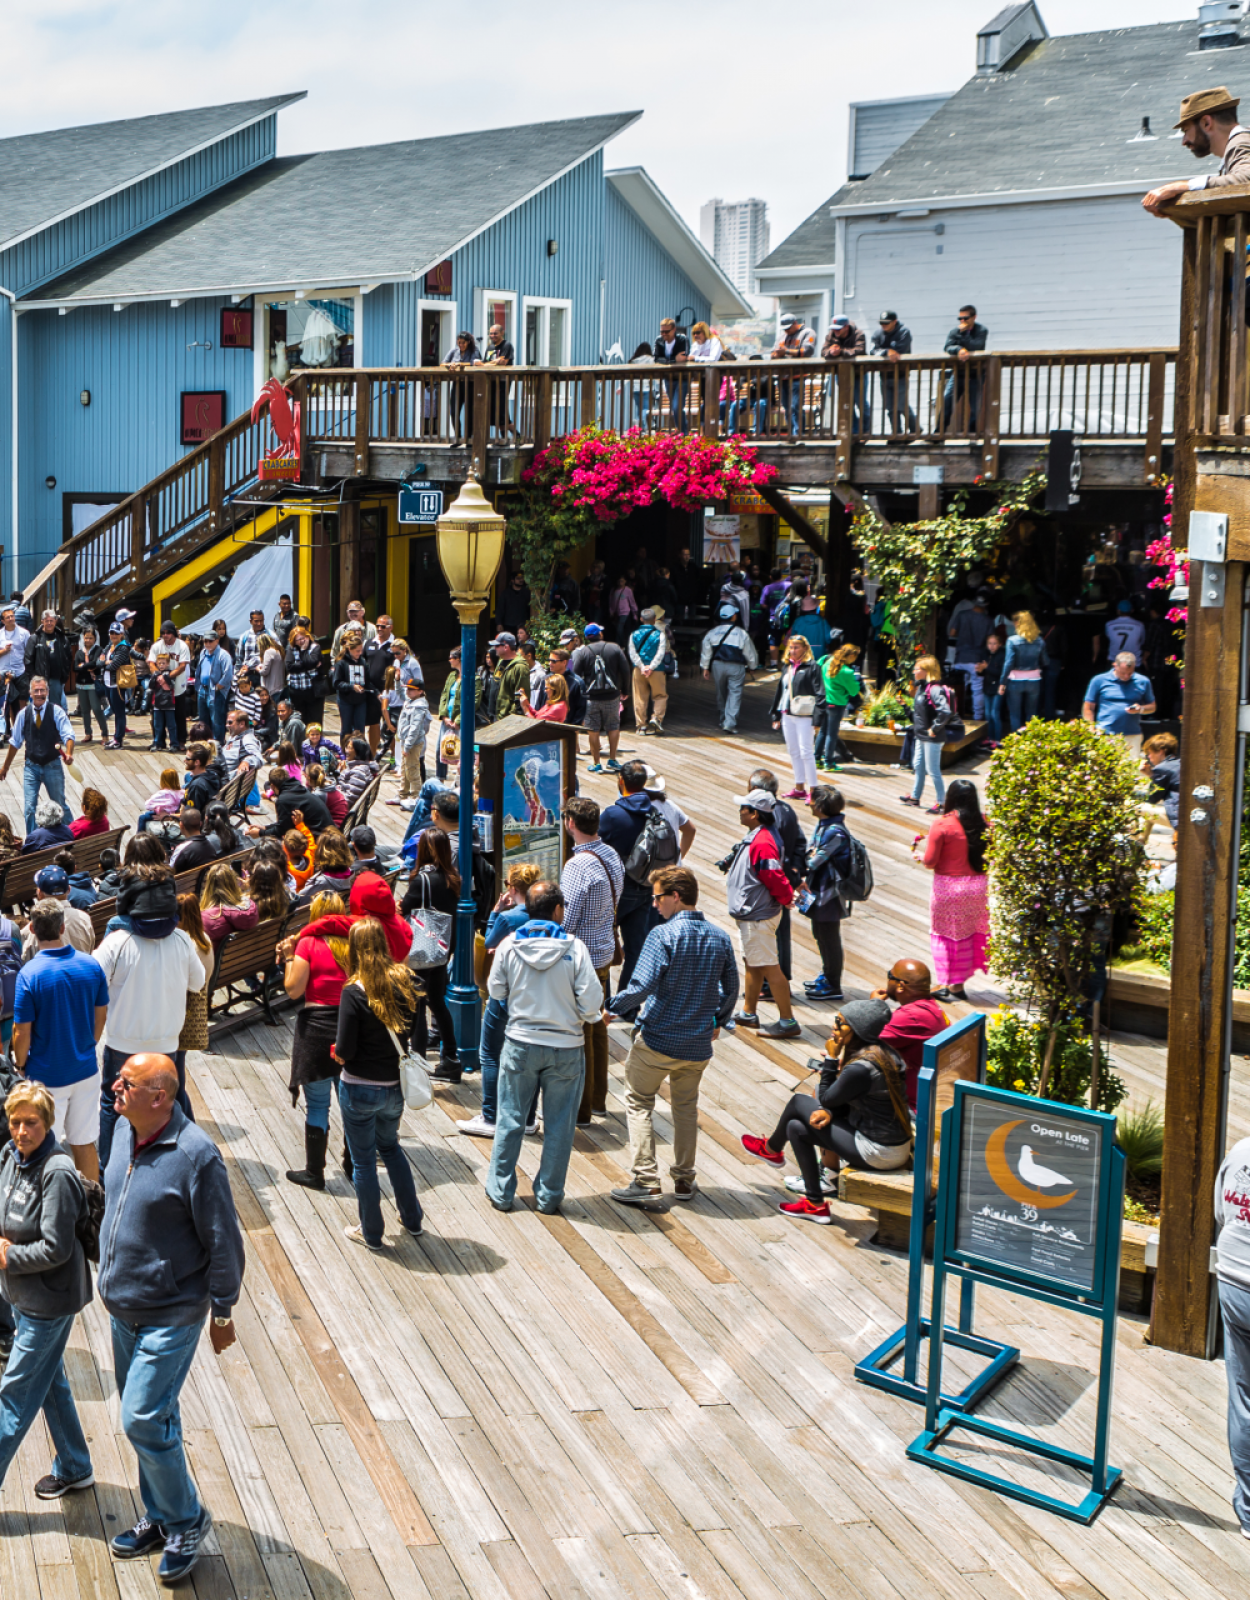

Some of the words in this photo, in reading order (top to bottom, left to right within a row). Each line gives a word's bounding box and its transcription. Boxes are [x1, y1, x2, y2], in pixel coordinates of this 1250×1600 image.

[405, 512, 436, 521] Elevator
[1117, 632, 1129, 650] 7
[1030, 1123, 1063, 1139] Open
[1065, 1131, 1090, 1145] Late
[1020, 1209, 1039, 1222] 39
